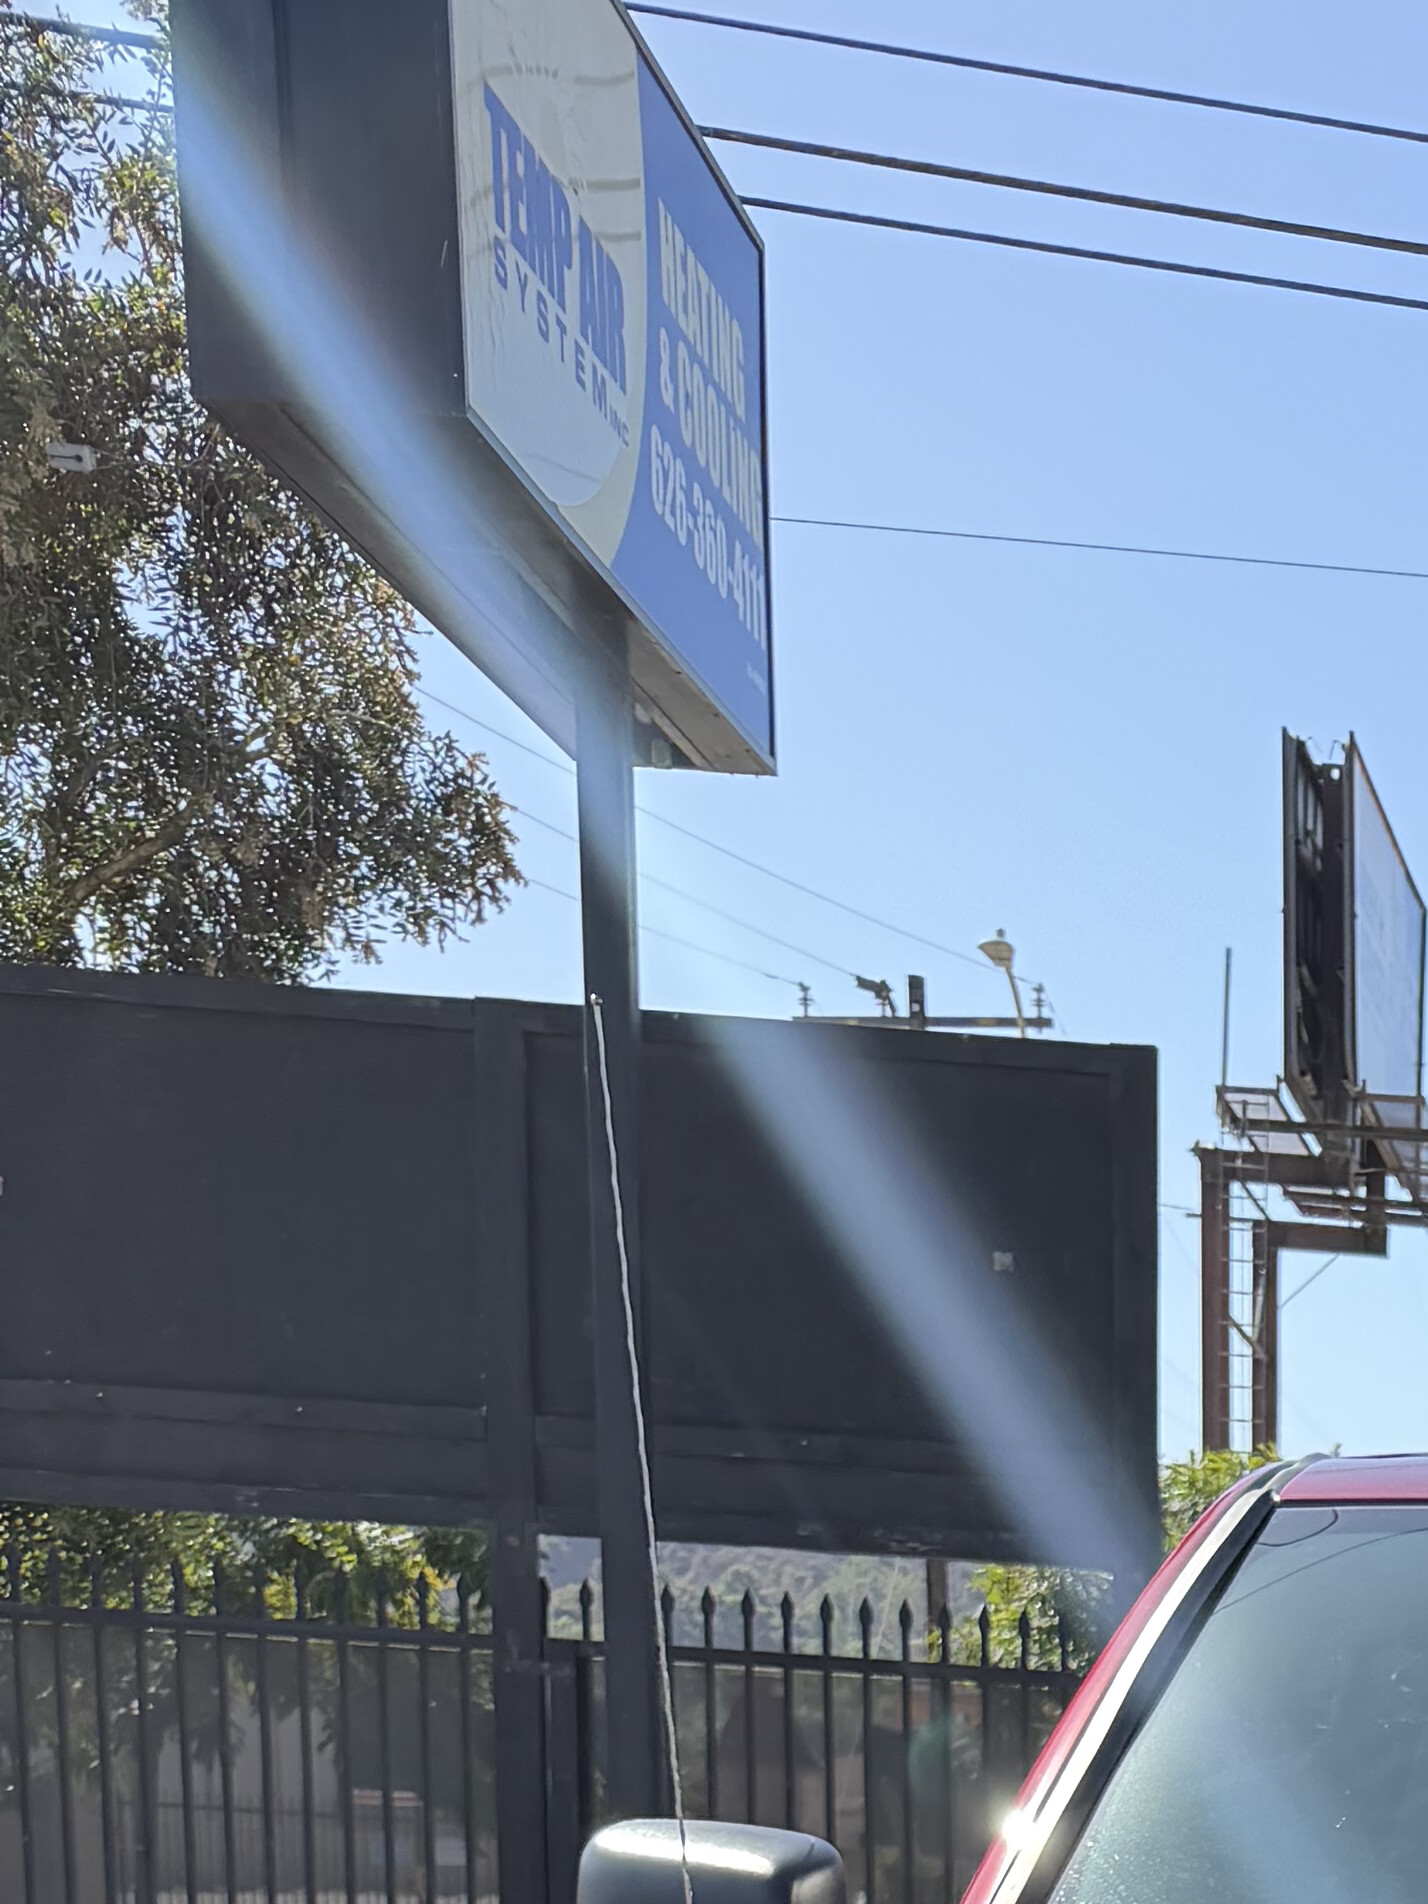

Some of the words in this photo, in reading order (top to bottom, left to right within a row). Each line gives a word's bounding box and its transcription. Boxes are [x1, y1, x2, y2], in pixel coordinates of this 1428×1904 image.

[484, 79, 573, 314] TEMP
[578, 212, 627, 397] AIR
[494, 234, 607, 420] SYSTEM
[658, 196, 746, 424] HEATING
[659, 326, 675, 414] &
[677, 340, 764, 549] COOLING
